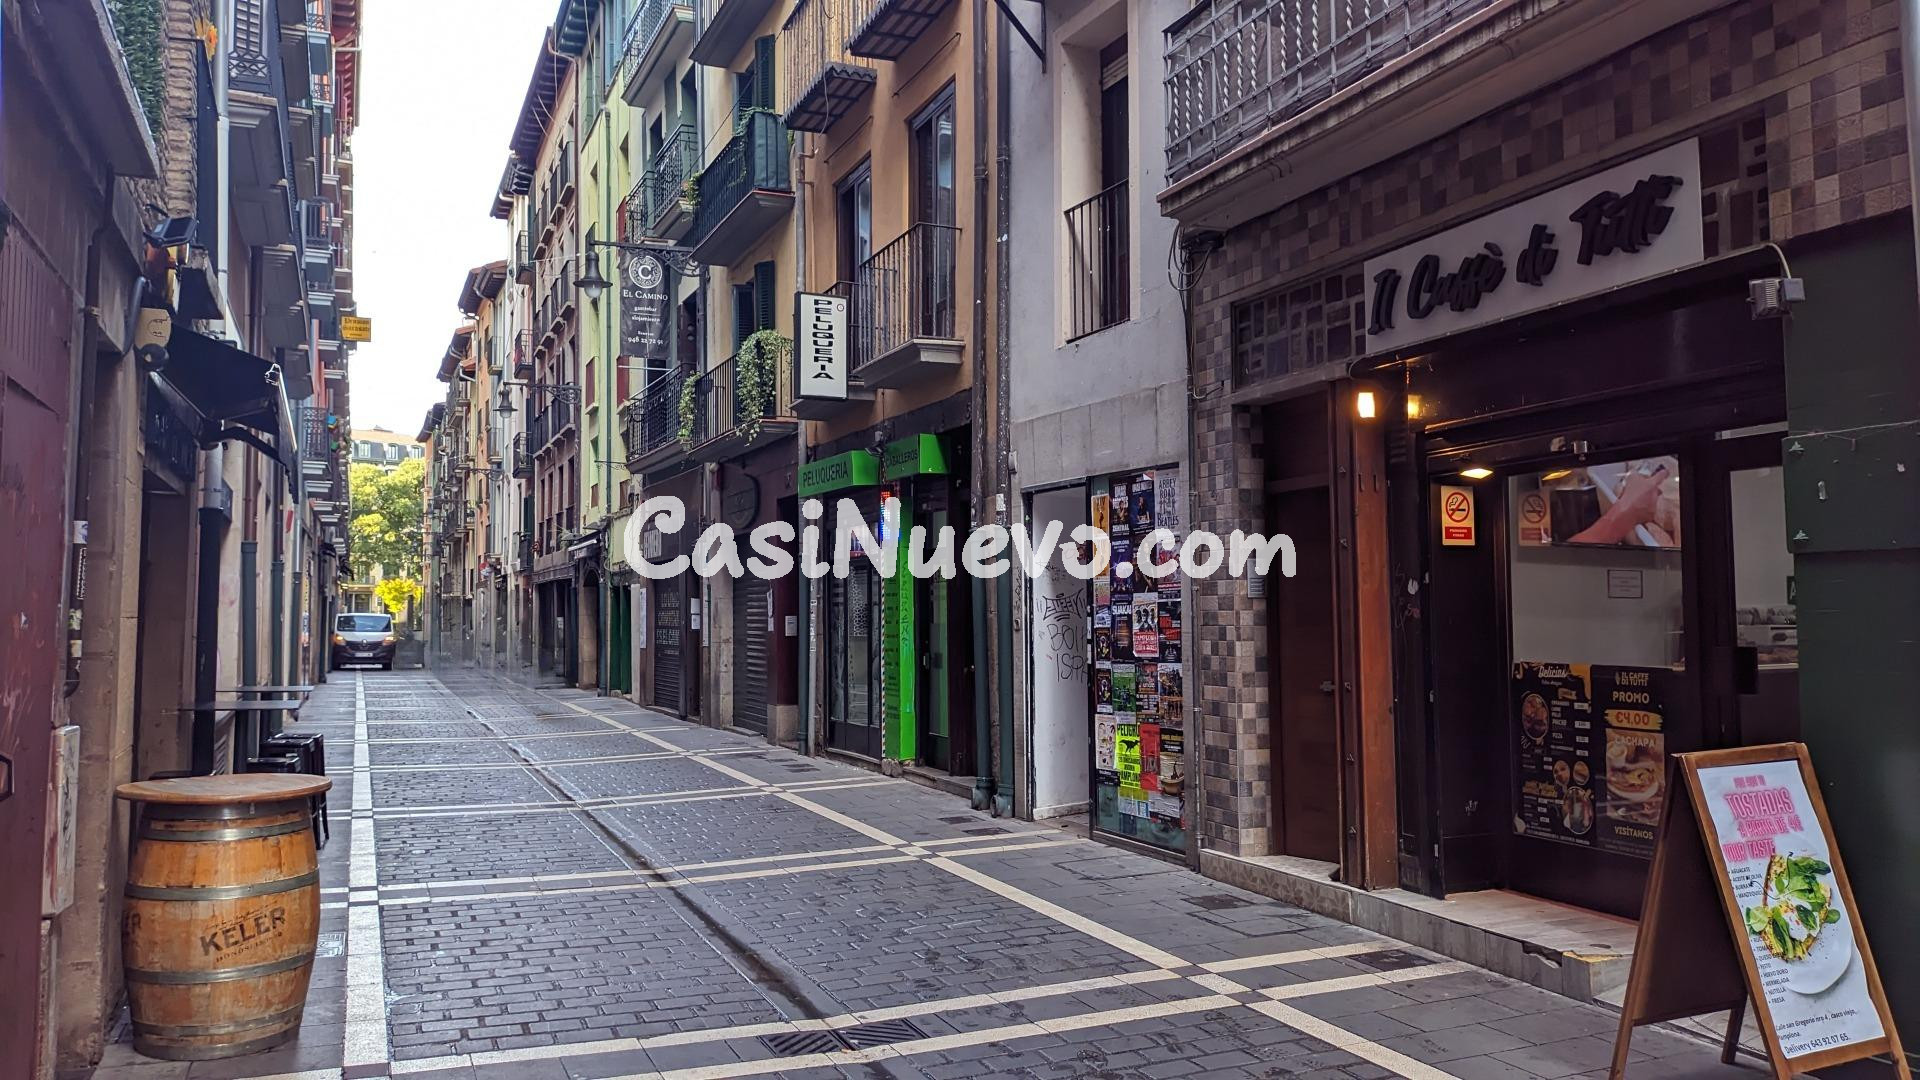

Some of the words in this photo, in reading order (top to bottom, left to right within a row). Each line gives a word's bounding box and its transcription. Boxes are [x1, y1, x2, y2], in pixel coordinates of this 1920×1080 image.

[1367, 268, 1400, 335] Il
[1406, 241, 1506, 319] Caffè
[1516, 223, 1559, 287] di
[1569, 174, 1684, 266] Tutti
[812, 299, 834, 380] PELUQUERIA
[802, 461, 849, 488] PELUQUERIA
[1160, 488, 1176, 500] ROAD
[1612, 691, 1650, 704] PROMO
[1615, 735, 1656, 748] CACHAPA
[1724, 787, 1794, 819] TOSTADAS
[1747, 839, 1776, 859] TASTE
[199, 905, 286, 957] KELER
[1794, 1018, 1816, 1027] Gregorio
[1783, 1041, 1811, 1054] Delivery
[1810, 1039, 1823, 1048] 643
[1822, 1037, 1832, 1046] 92
